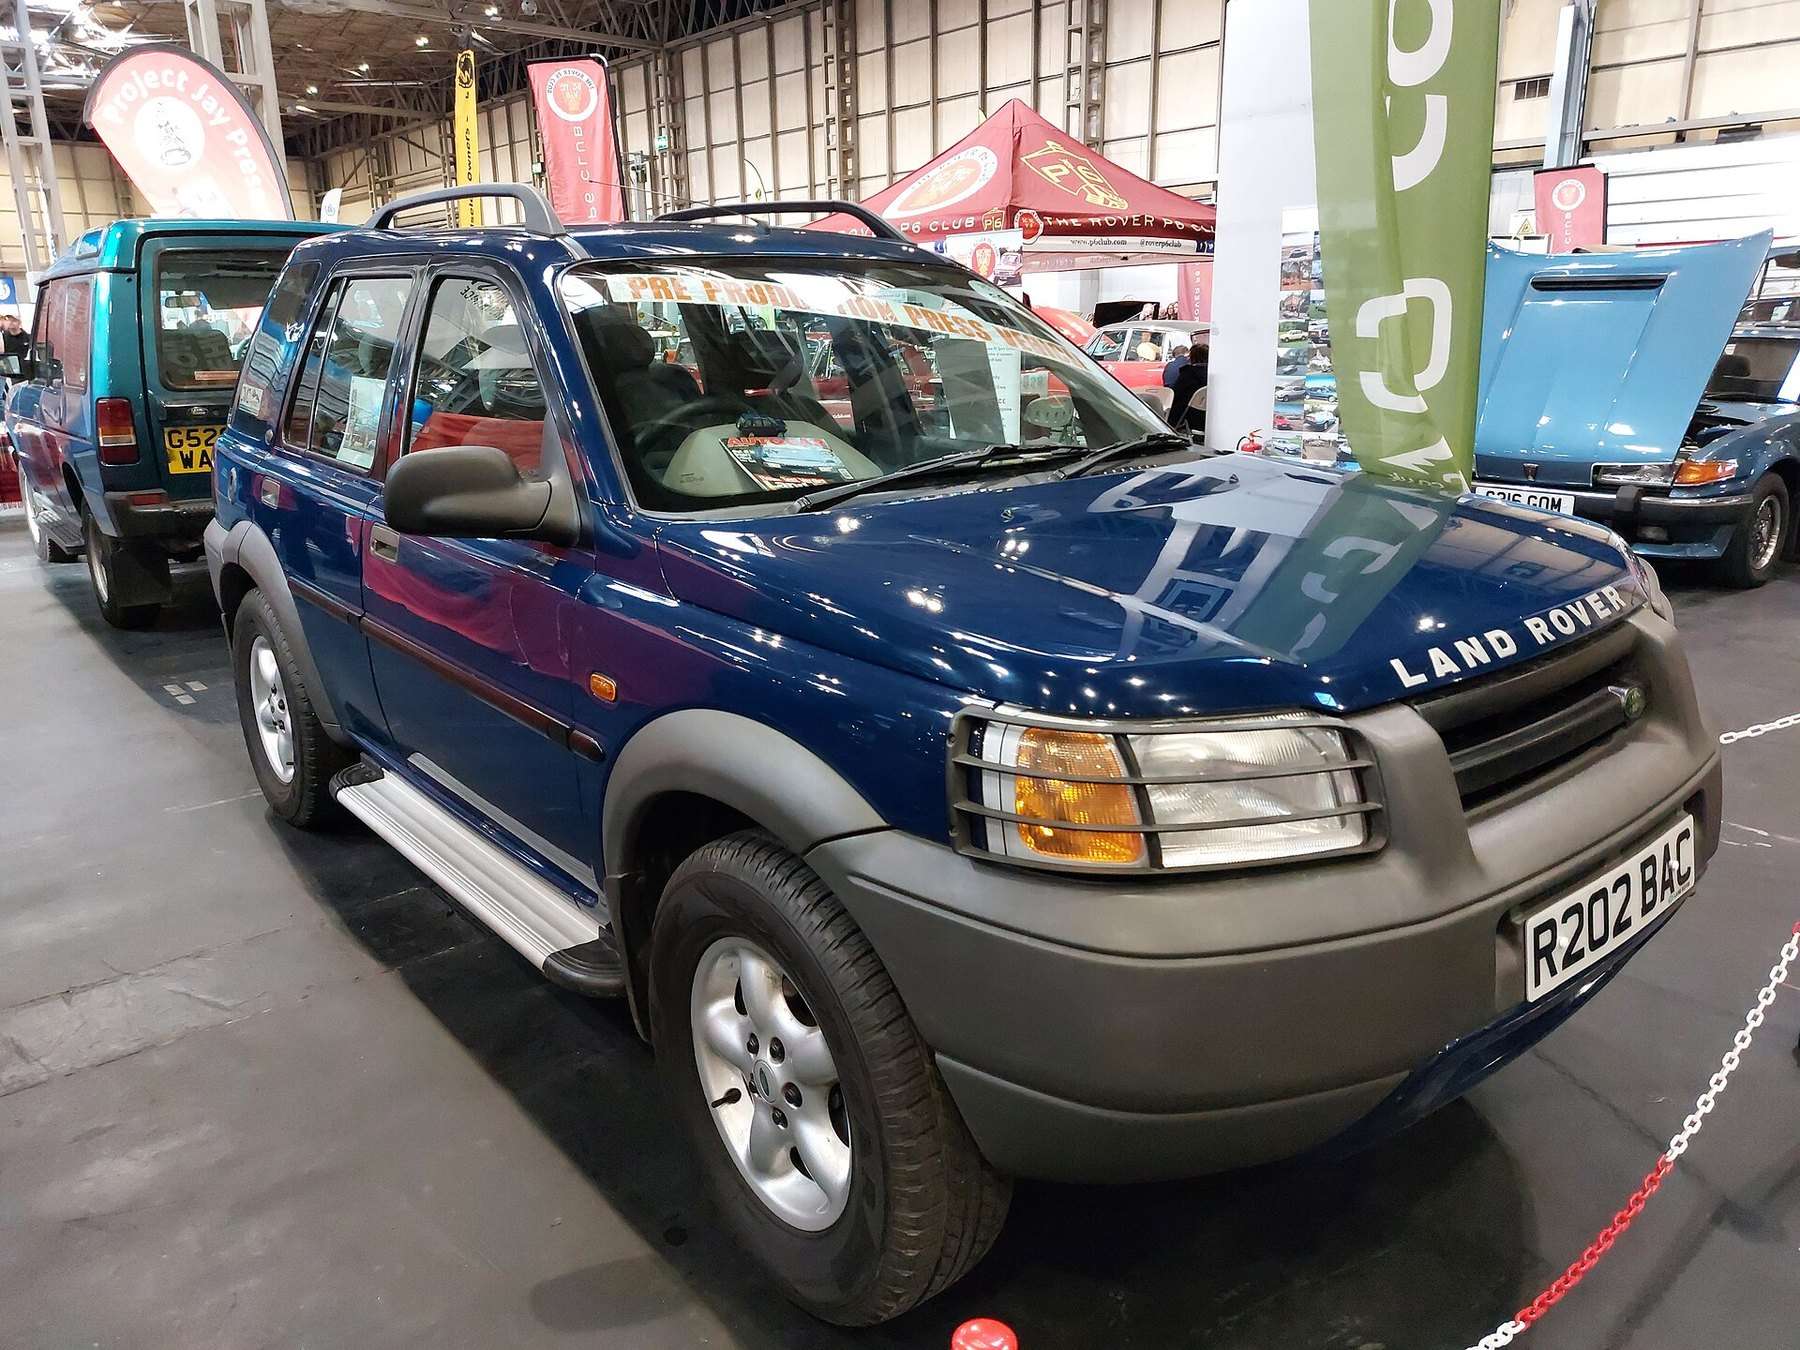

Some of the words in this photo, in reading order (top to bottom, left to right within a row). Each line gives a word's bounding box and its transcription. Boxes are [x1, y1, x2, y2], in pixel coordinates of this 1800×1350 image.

[102, 68, 189, 124] Project
[191, 83, 231, 126] Jay
[900, 221, 921, 233] P6
[929, 216, 975, 231] CLUB
[1043, 216, 1082, 226] THE
[1090, 215, 1155, 227] ROVER
[1162, 217, 1185, 230] P6
[1139, 239, 1182, 249] @roverp6club
[628, 276, 692, 301] PRE
[900, 304, 993, 342] PRESS
[1389, 628, 1519, 689] LAND
[1523, 584, 1628, 646] ROVER
[1533, 872, 1633, 989] R202
[1639, 827, 1692, 919] BAC
